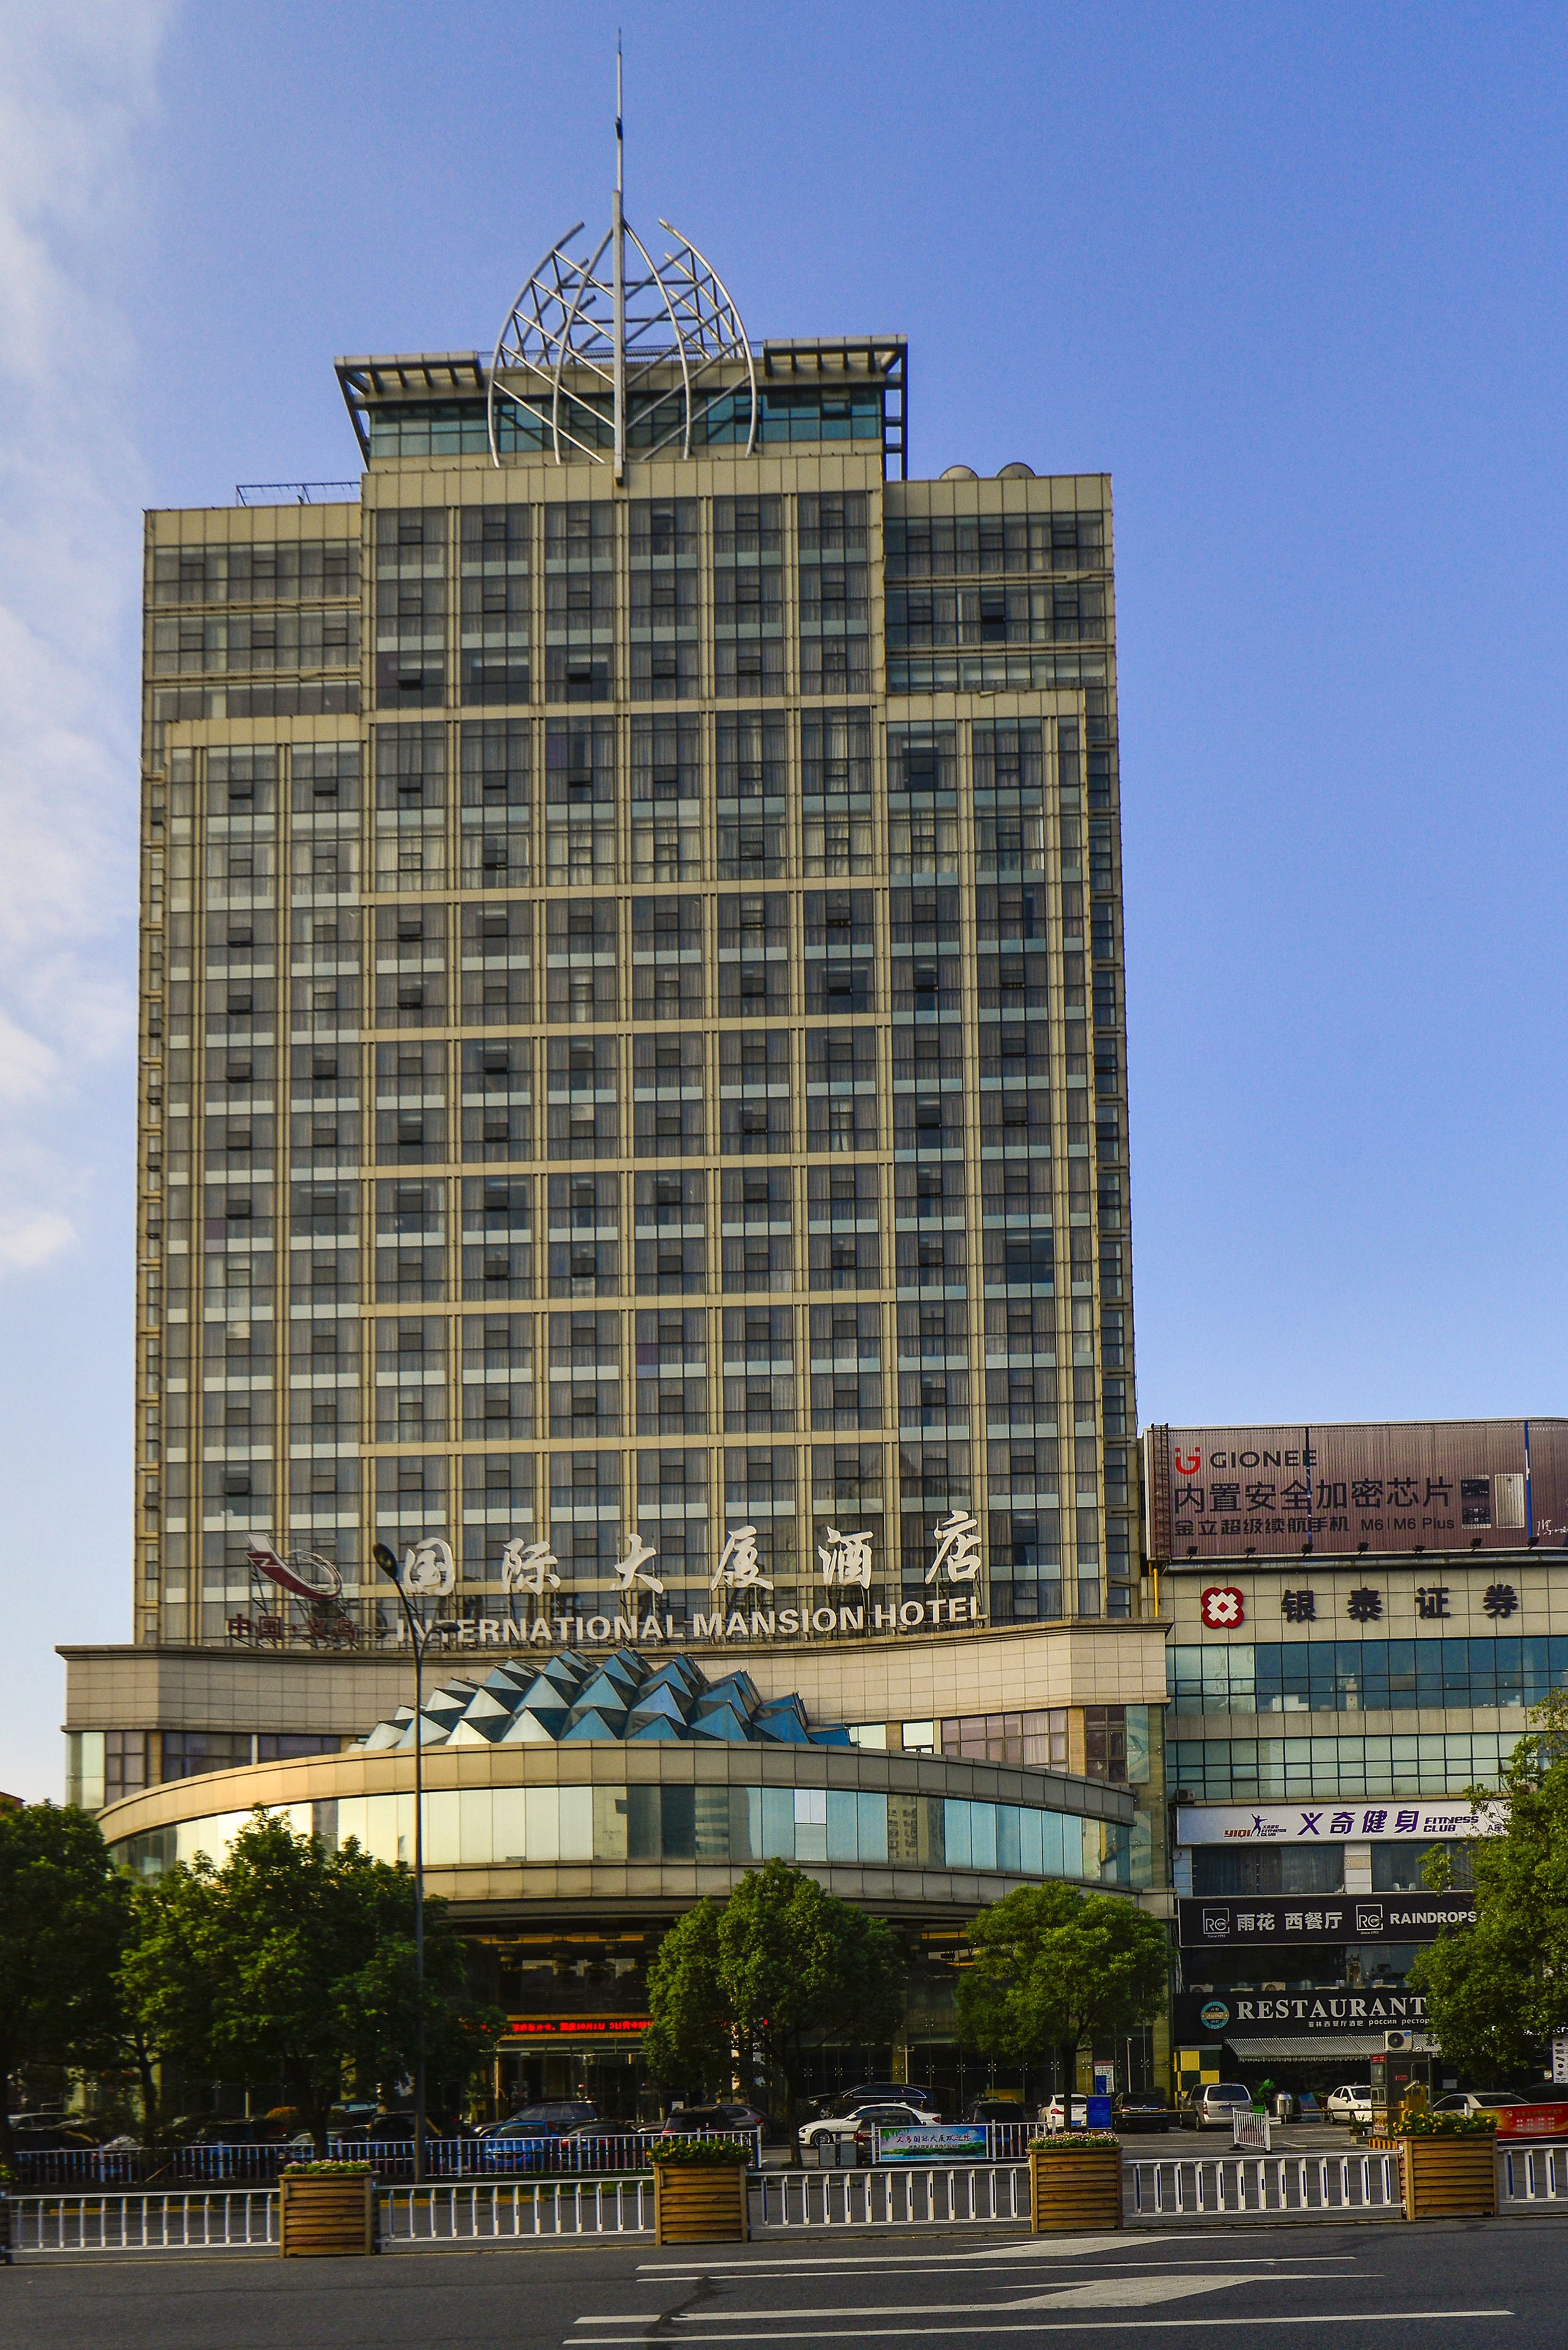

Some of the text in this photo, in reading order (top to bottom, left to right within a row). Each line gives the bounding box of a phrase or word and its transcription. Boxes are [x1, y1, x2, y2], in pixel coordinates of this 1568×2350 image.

[1211, 1449, 1317, 1468] GIONEE
[1174, 1476, 1454, 1514] 内置安全加密芯片
[1174, 1516, 1350, 1537] 金立超级续航手机
[1422, 1516, 1455, 1529] Plus
[403, 1510, 982, 1596] 国际大厦酒店
[1281, 1583, 1518, 1624] 银泰证券
[693, 1605, 865, 1637] MANSION
[875, 1595, 988, 1629] HOTEL
[1423, 1824, 1457, 1833] CLUB
[1236, 1911, 1343, 1931] 雨花 西餐厅
[1390, 1911, 1477, 1925] RAINDROPS
[1236, 1997, 1427, 2020] RESTAURANT
